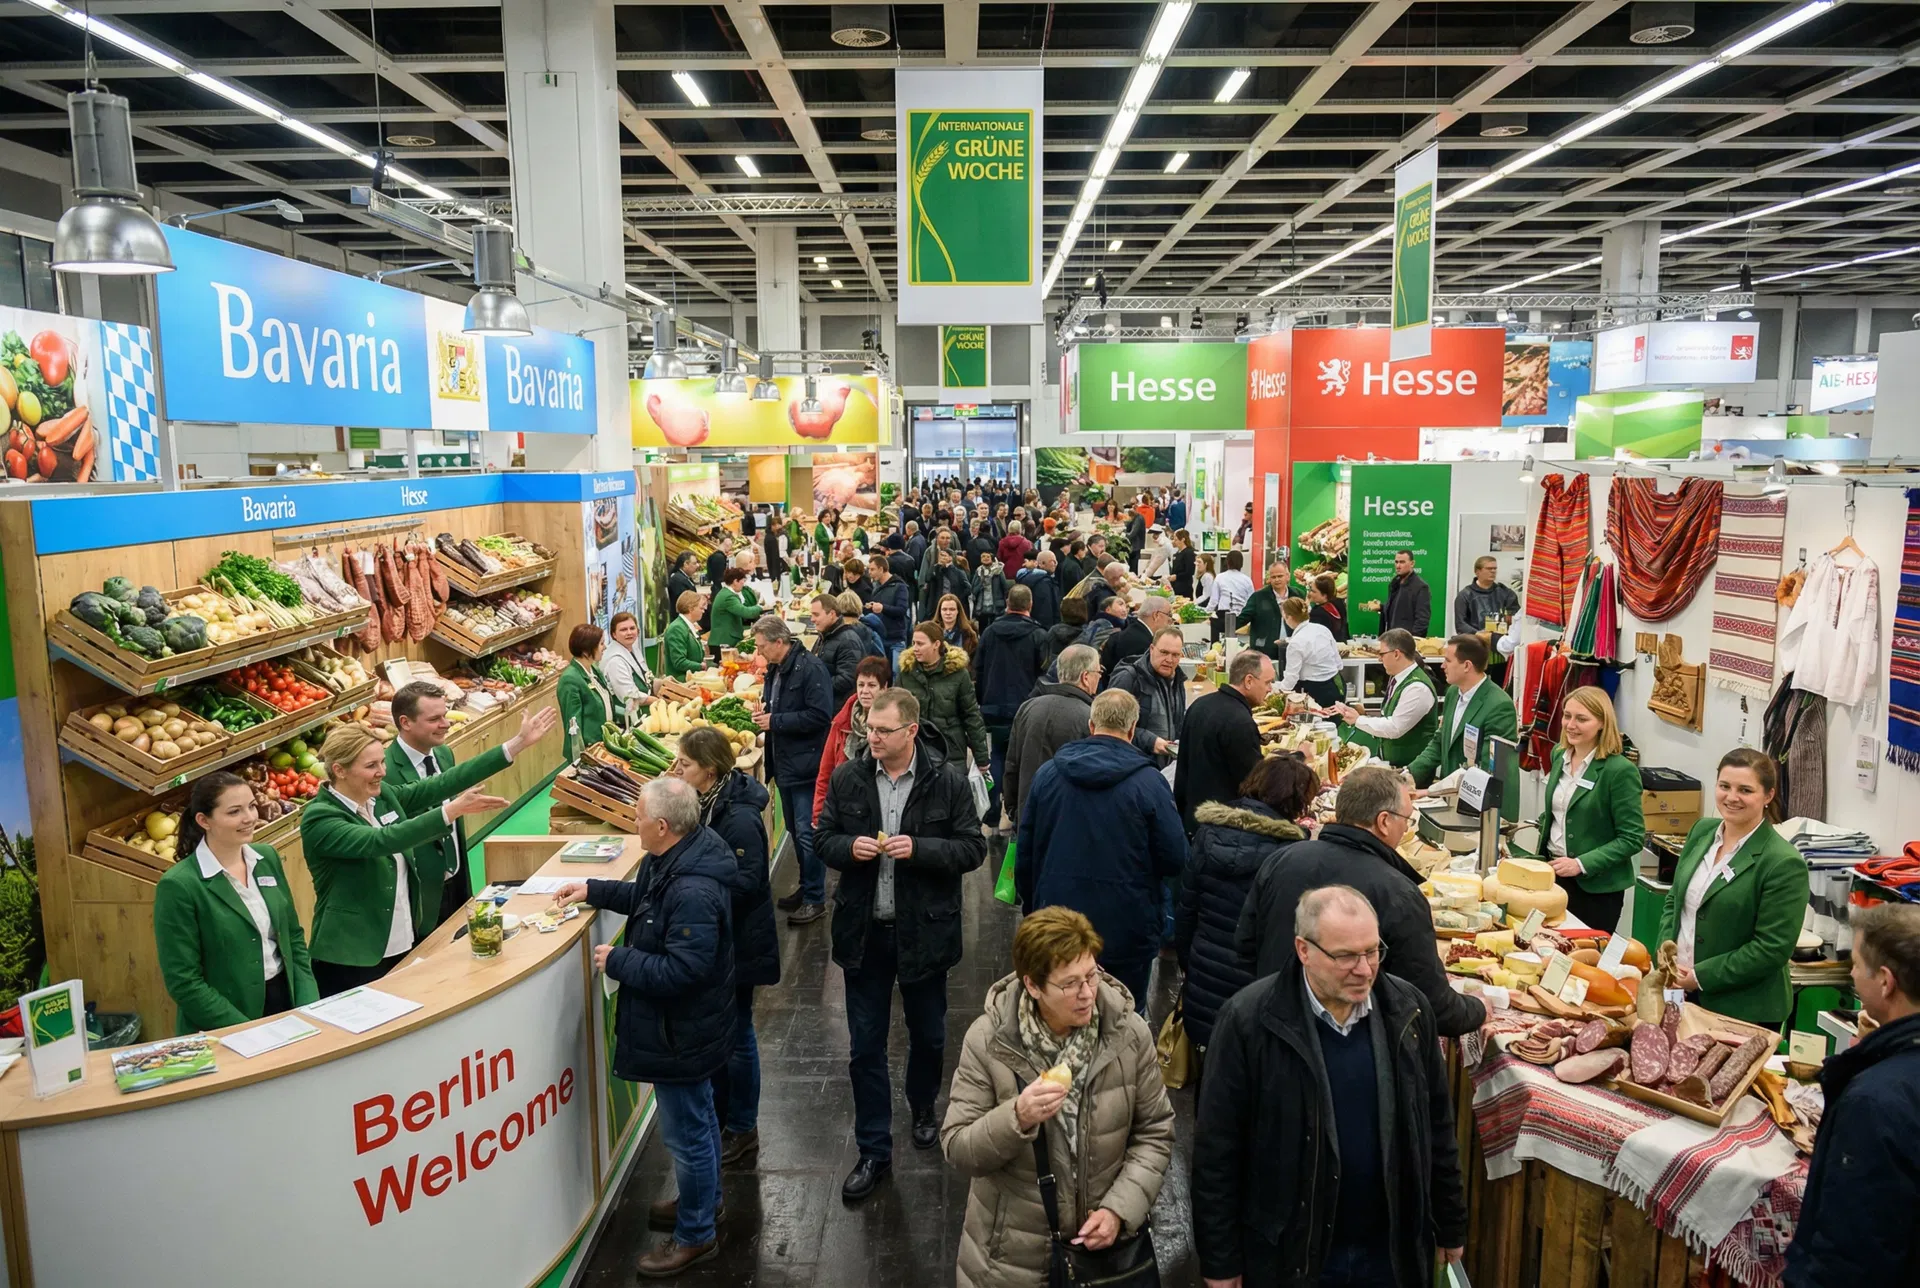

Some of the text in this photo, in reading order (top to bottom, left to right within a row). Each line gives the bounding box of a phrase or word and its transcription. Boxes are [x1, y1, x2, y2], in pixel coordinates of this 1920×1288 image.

[938, 121, 1025, 131] INTERNATIONALE
[954, 135, 1025, 157] GRÜNE
[947, 162, 1025, 180] WOCHE
[210, 281, 402, 394] Bavaria
[502, 344, 584, 411] Bavaria
[1111, 371, 1217, 401] Hesse
[1259, 369, 1287, 399] Hesse
[1363, 362, 1478, 396] Hesse
[241, 494, 297, 522] Bavaria
[400, 485, 428, 506] Hesse
[1364, 495, 1434, 516] Hesse
[353, 1048, 515, 1156] Berlin
[353, 1067, 574, 1227] Welcome
